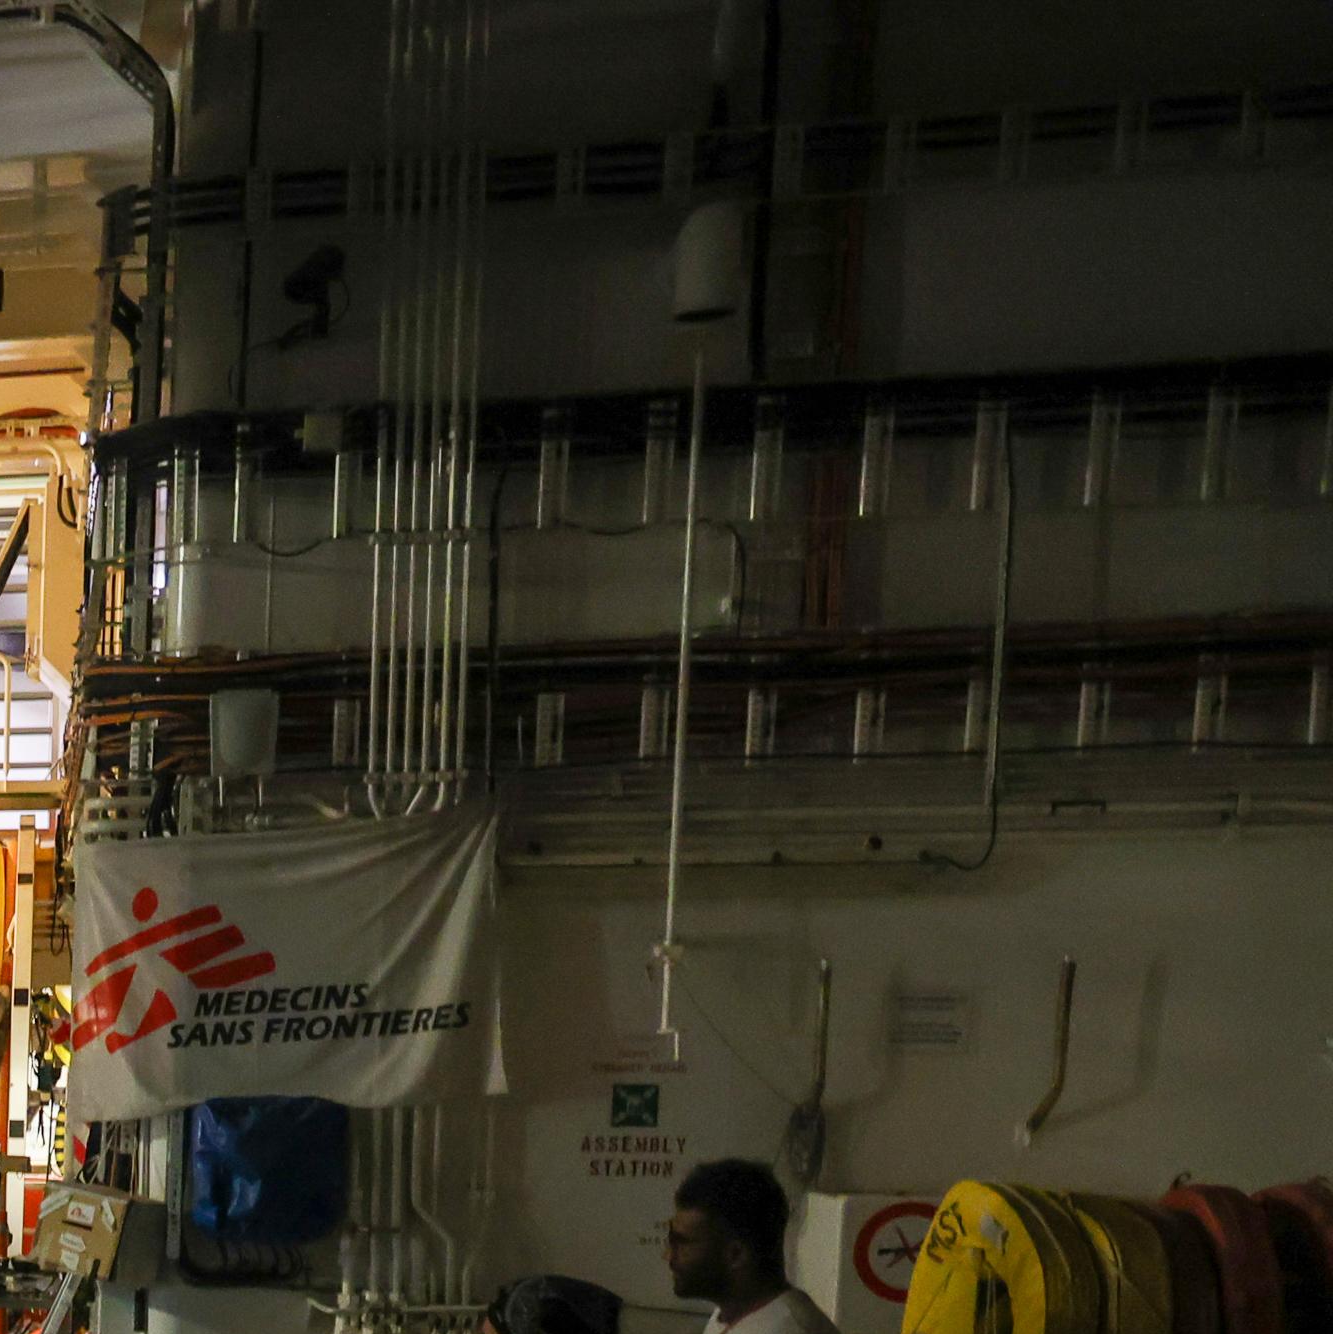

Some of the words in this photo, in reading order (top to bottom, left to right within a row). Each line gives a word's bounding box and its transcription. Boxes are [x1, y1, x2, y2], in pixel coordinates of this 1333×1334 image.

[193, 983, 369, 1017] MEDECINS
[167, 1020, 254, 1049] SANS
[262, 1002, 471, 1044] FRONTIERES
[580, 1135, 686, 1155] ASSEMBLY
[588, 1158, 674, 1177] STATION
